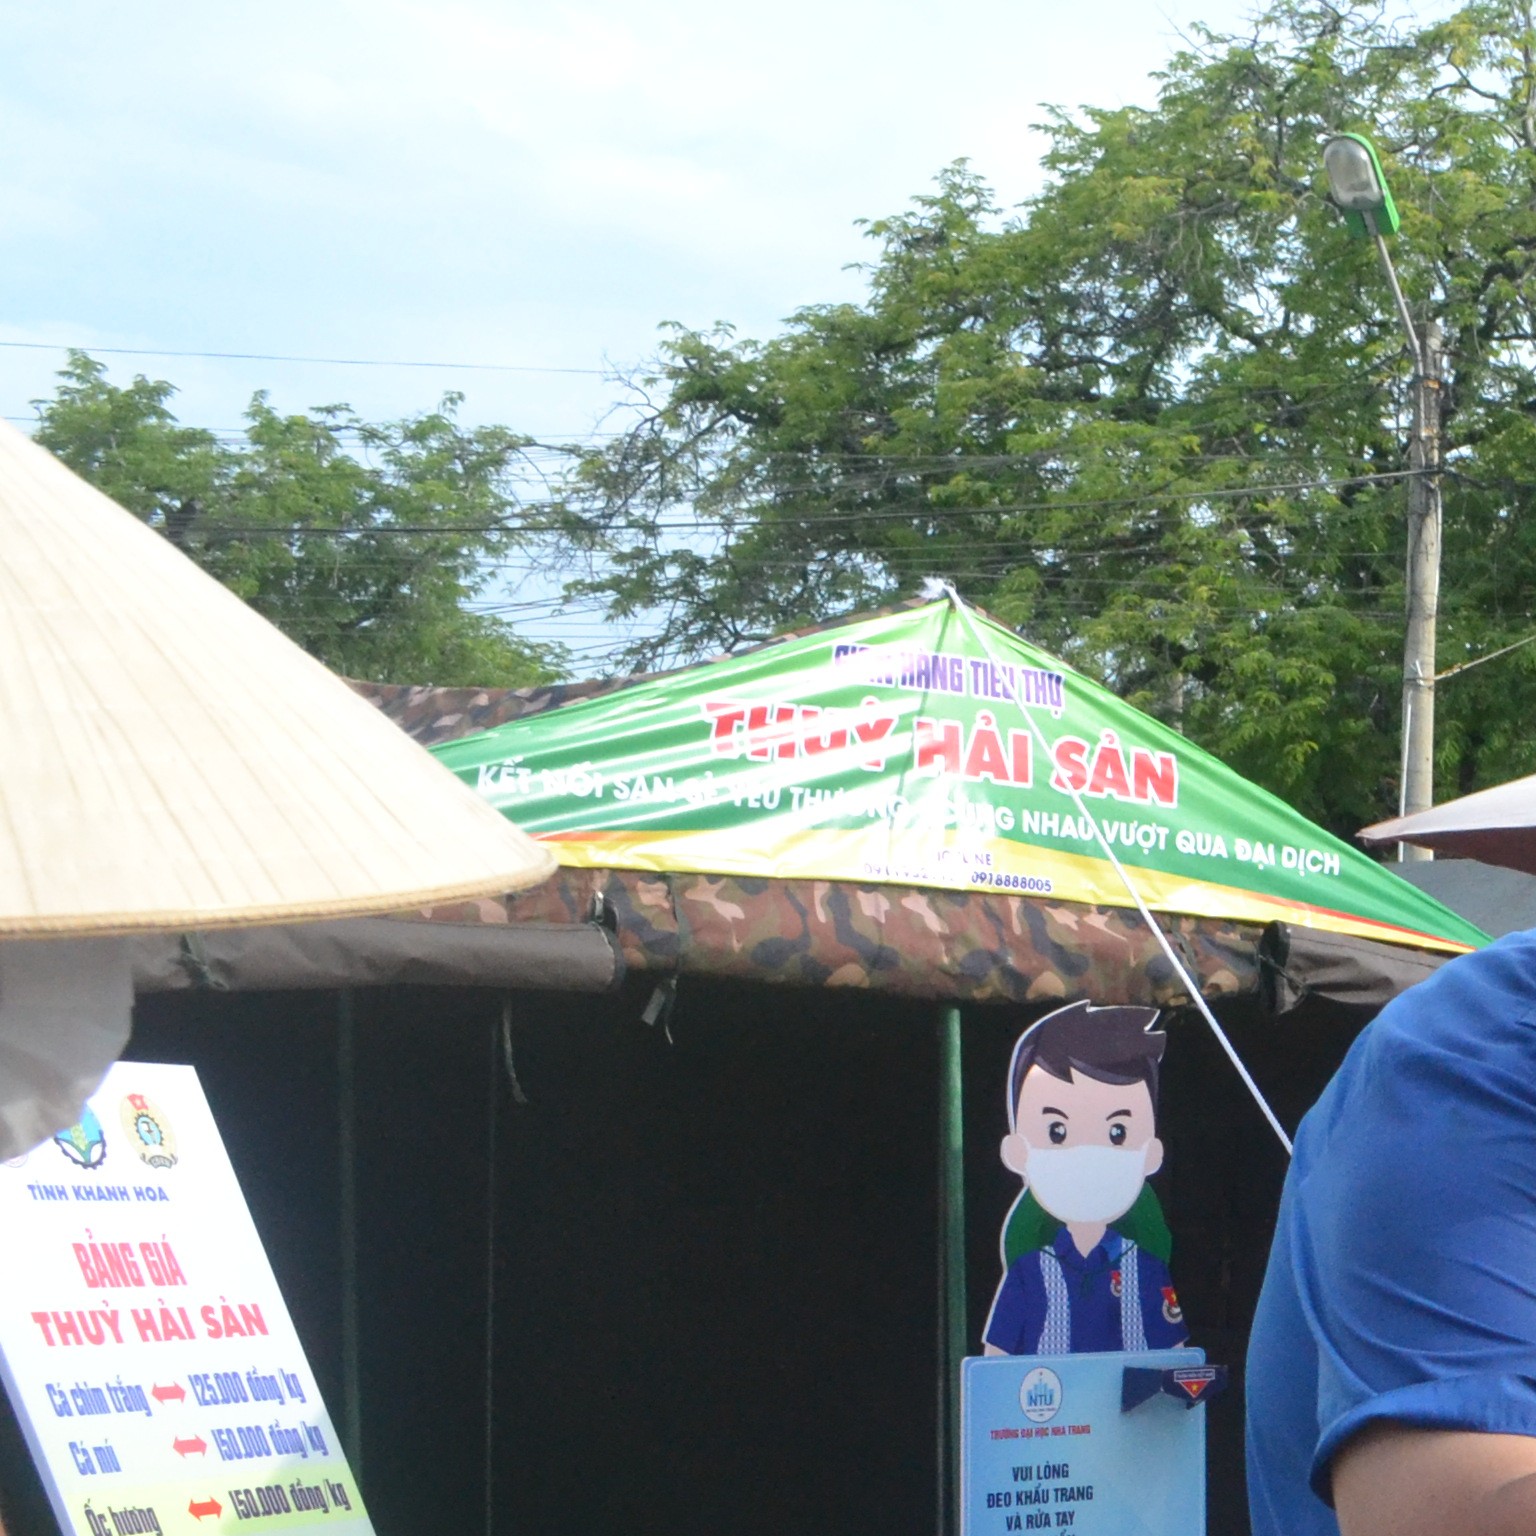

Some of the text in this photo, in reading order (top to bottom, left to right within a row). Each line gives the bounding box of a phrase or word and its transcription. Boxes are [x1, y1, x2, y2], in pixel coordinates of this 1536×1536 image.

[1022, 669, 1063, 715] THỤ
[916, 715, 1029, 783] HẢI
[1055, 734, 1174, 803] SẢN
[1023, 809, 1093, 841] NHAU
[1102, 820, 1169, 855] VƯỢT
[1175, 830, 1228, 859] QUA
[1234, 837, 1276, 870] ĐẠI
[1281, 846, 1340, 876] DỊCH
[971, 871, 1052, 891] 0918888005
[72, 1228, 187, 1288] BẢNG GIÁ
[31, 1296, 269, 1346] THUỶ HẢI SẢN
[45, 1383, 74, 1417] Cá
[70, 1382, 111, 1416] chim
[105, 1375, 153, 1417] trắng
[188, 1372, 249, 1406] 125.000
[1028, 1394, 1053, 1406] NTU
[68, 1440, 97, 1476] Cá
[92, 1438, 122, 1474] mú
[211, 1425, 272, 1461] 150.000
[1012, 1461, 1069, 1482] VUI LÒNG
[108, 1506, 164, 1536] hương
[228, 1485, 292, 1520] 150.000
[986, 1482, 1094, 1509] ĐEO KHẨU TRANG
[1006, 1508, 1075, 1531] VÀ RỬA TAY
